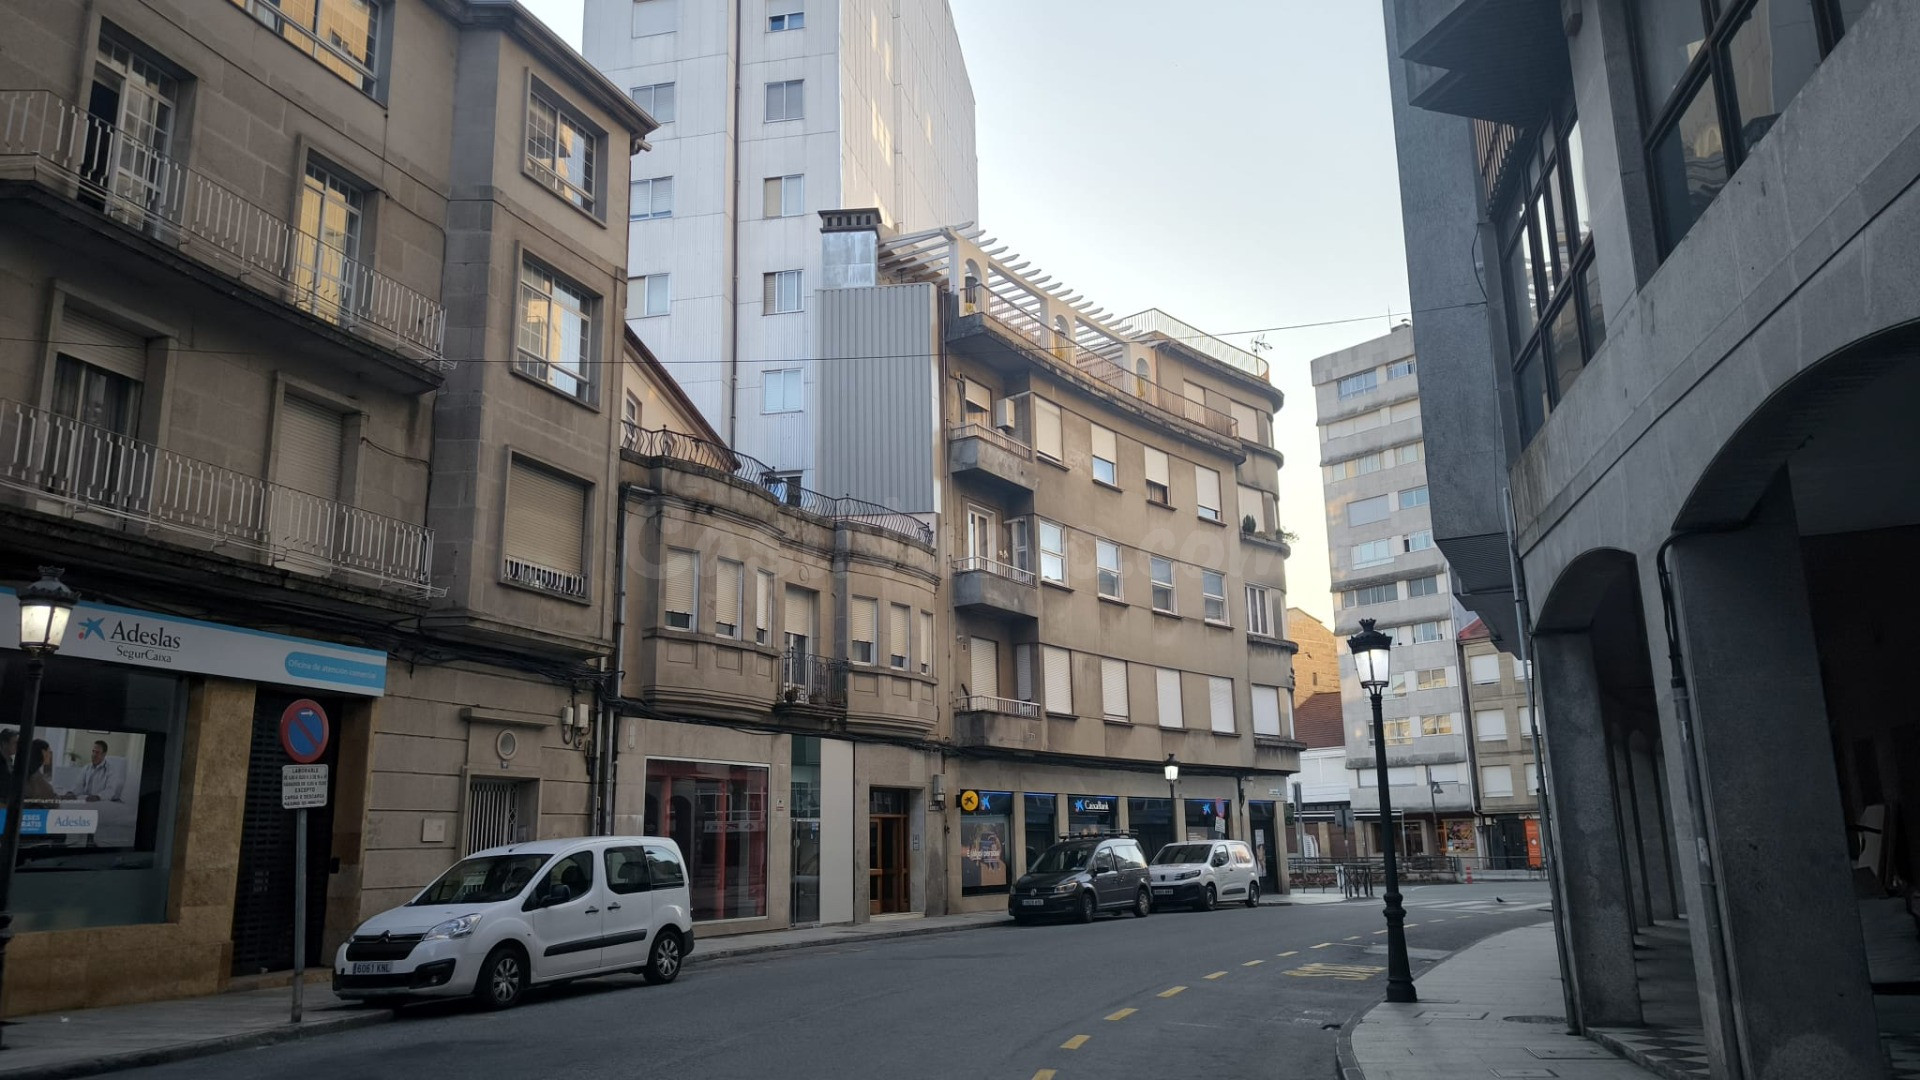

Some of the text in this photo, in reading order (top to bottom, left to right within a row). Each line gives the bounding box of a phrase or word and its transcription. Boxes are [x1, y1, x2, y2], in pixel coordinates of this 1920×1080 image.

[110, 619, 181, 649] Adeslas
[116, 644, 172, 663] SegurCaixa
[55, 815, 91, 827] Adeslas
